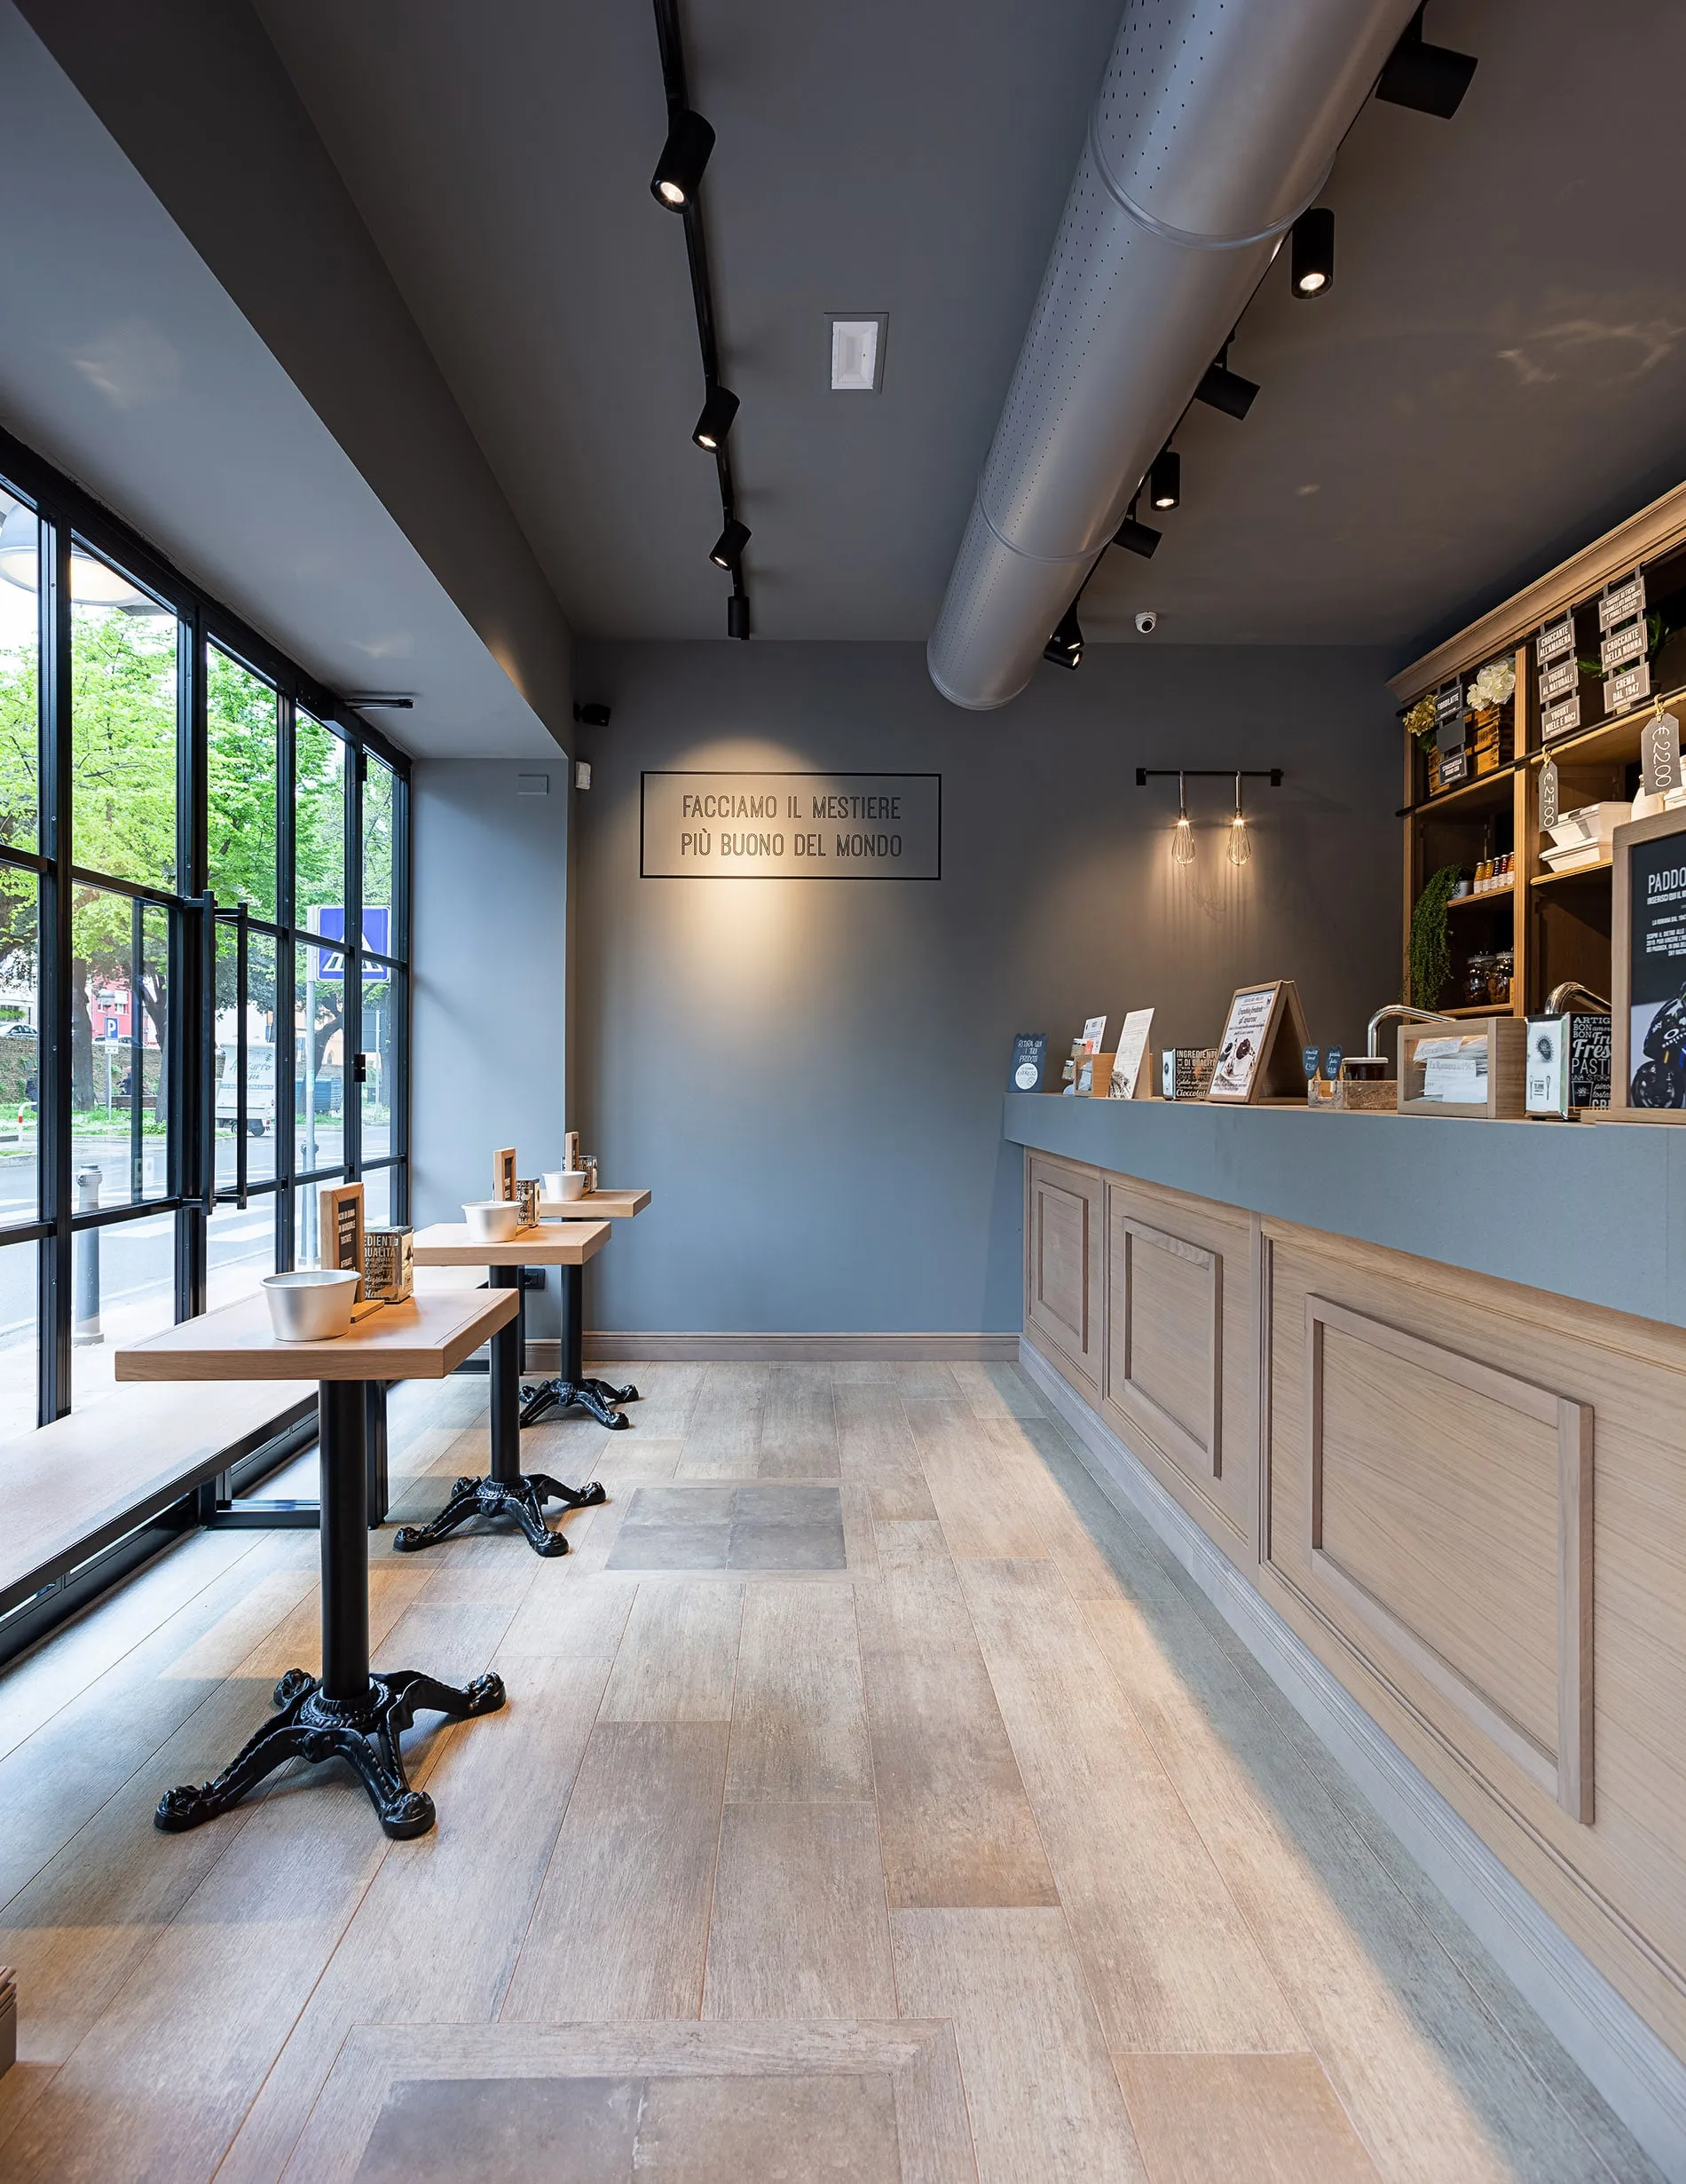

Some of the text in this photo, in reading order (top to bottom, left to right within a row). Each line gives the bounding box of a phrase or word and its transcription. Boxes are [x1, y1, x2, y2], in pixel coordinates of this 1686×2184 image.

[1541, 625, 1569, 648] CROCCANTE
[1607, 628, 1639, 652] CROCCANTE
[1605, 650, 1622, 663] DELLA
[1623, 638, 1642, 655] NONNA
[1543, 686, 1549, 696] AL
[1549, 673, 1574, 692] NATURALE
[1548, 666, 1566, 683] YOGURT
[1616, 674, 1635, 690] CREMA
[1613, 690, 1623, 702] DAL
[1625, 682, 1639, 697] 1947
[1551, 704, 1569, 720] YOGURT
[1560, 717, 1564, 726] E
[1653, 741, 1672, 787] 22.00
[682, 795, 901, 820] FACCIAMO IL MESTIERE
[1544, 787, 1554, 827] 27.00
[681, 828, 902, 858] PIÙ BUONO DEL MONDO
[107, 1019, 116, 1037] P
[1572, 1039, 1611, 1058] Fres
[1572, 1058, 1610, 1074] PASTI
